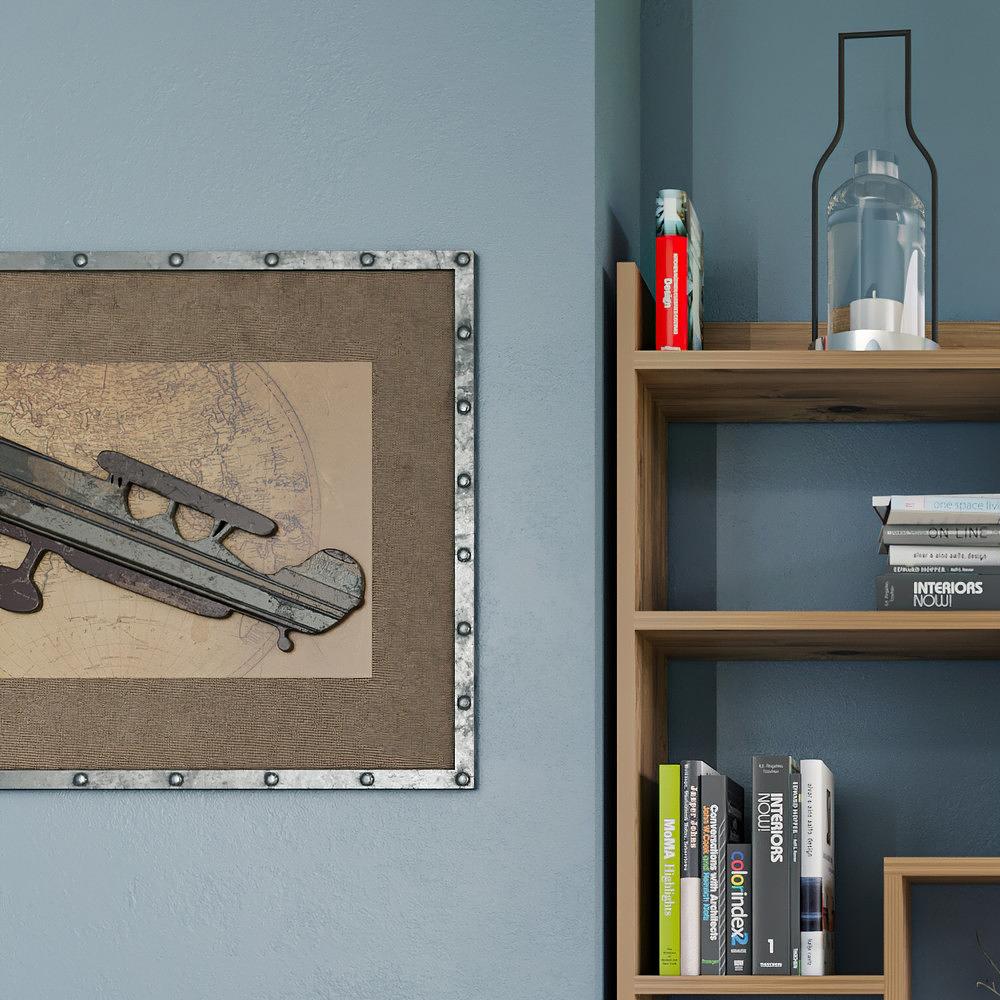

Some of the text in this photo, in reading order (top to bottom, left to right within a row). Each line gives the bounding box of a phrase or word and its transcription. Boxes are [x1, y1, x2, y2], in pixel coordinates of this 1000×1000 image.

[663, 278, 673, 308] Design
[955, 502, 983, 512] space
[913, 581, 983, 595] INTERIORS
[757, 793, 770, 832] NOW!
[770, 793, 783, 863] INTERIORS
[662, 818, 675, 916] MoMA Highlights
[710, 804, 718, 941] Conversations with Architects
